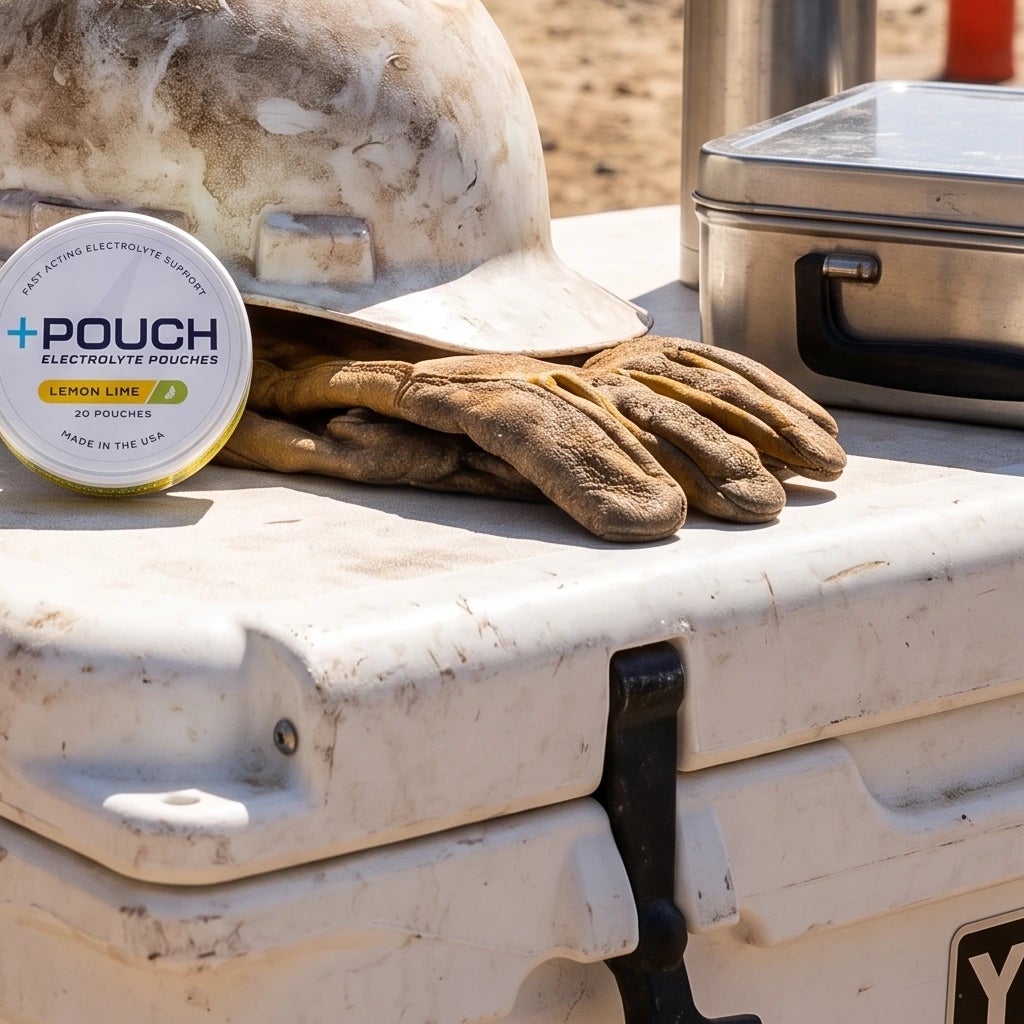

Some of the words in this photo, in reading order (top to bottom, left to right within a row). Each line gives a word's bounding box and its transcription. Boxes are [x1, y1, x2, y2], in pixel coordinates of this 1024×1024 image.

[22, 272, 43, 296] FAST
[44, 247, 83, 273] ACTING
[85, 241, 162, 260] ELECTROLYTE
[41, 354, 144, 365] ELECTROLYTE
[148, 355, 219, 365] POUCHES
[49, 387, 100, 397] LEMON
[105, 387, 140, 397] LIME
[74, 410, 90, 418] 20
[94, 410, 152, 418] POUCHES
[61, 430, 94, 449] MADE
[98, 441, 110, 450] IN
[115, 440, 137, 450] THE
[141, 431, 165, 446] USA
